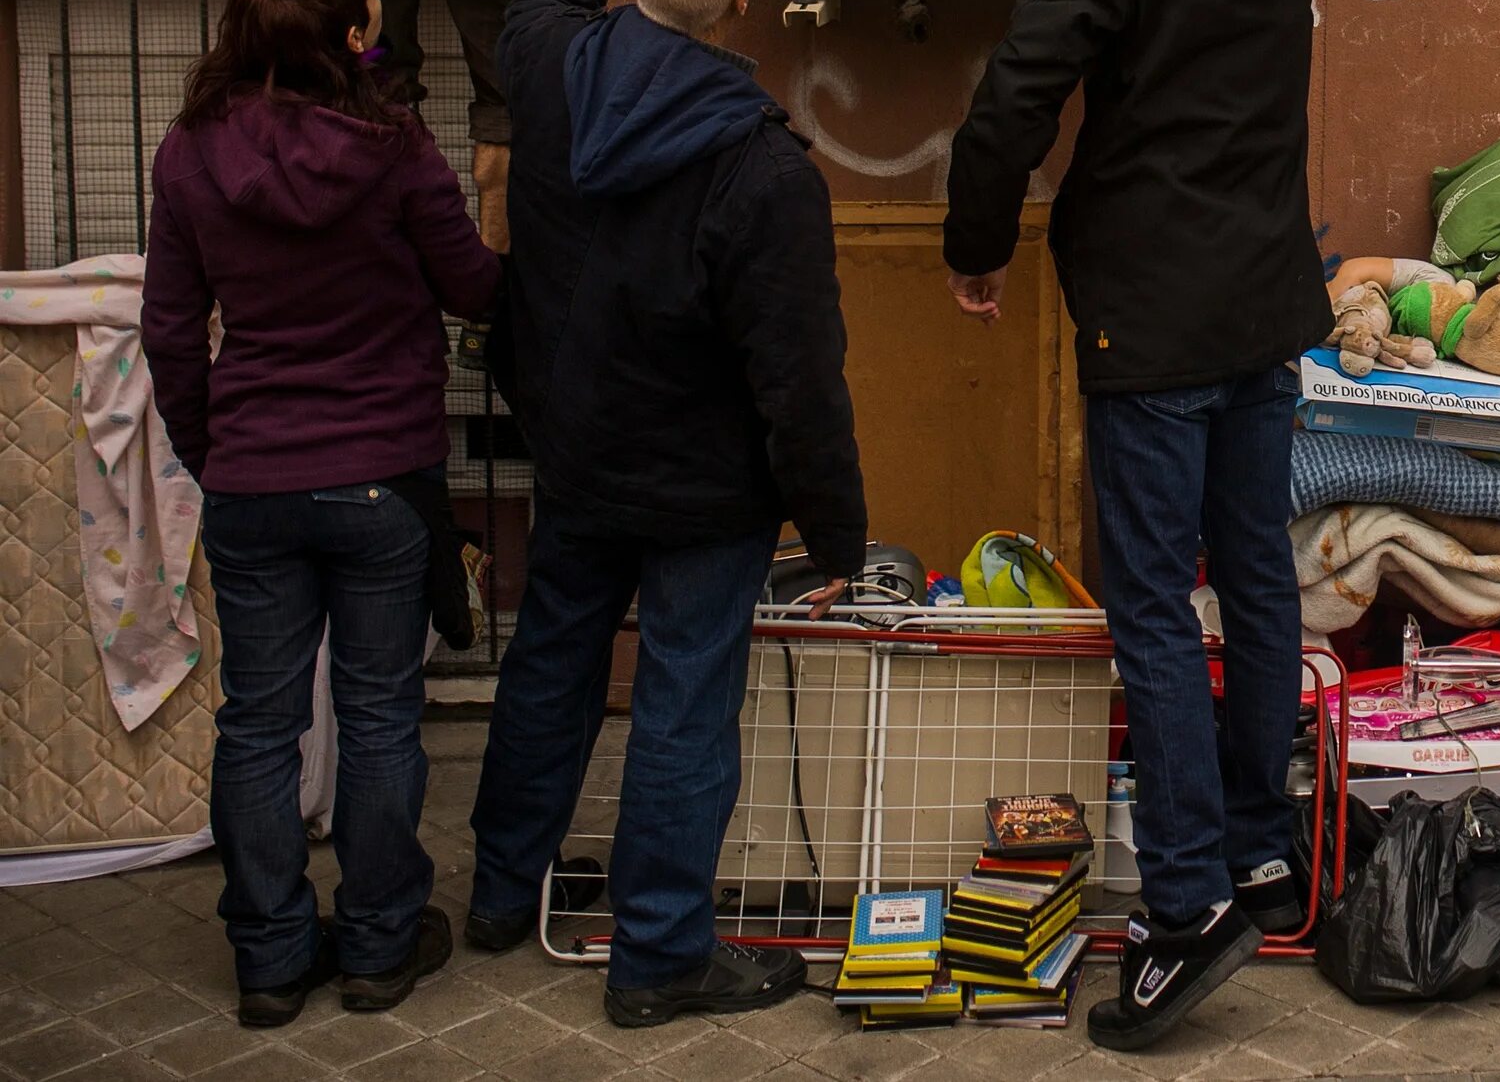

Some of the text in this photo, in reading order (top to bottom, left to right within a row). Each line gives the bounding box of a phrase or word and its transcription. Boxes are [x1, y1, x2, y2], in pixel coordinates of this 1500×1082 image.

[1313, 383, 1338, 397] QUE
[1341, 386, 1370, 399] DIOS
[1376, 389, 1429, 405] BENDIGA
[1430, 395, 1462, 408] CADA
[1262, 864, 1285, 879] VANS
[1143, 967, 1165, 990] VANS
